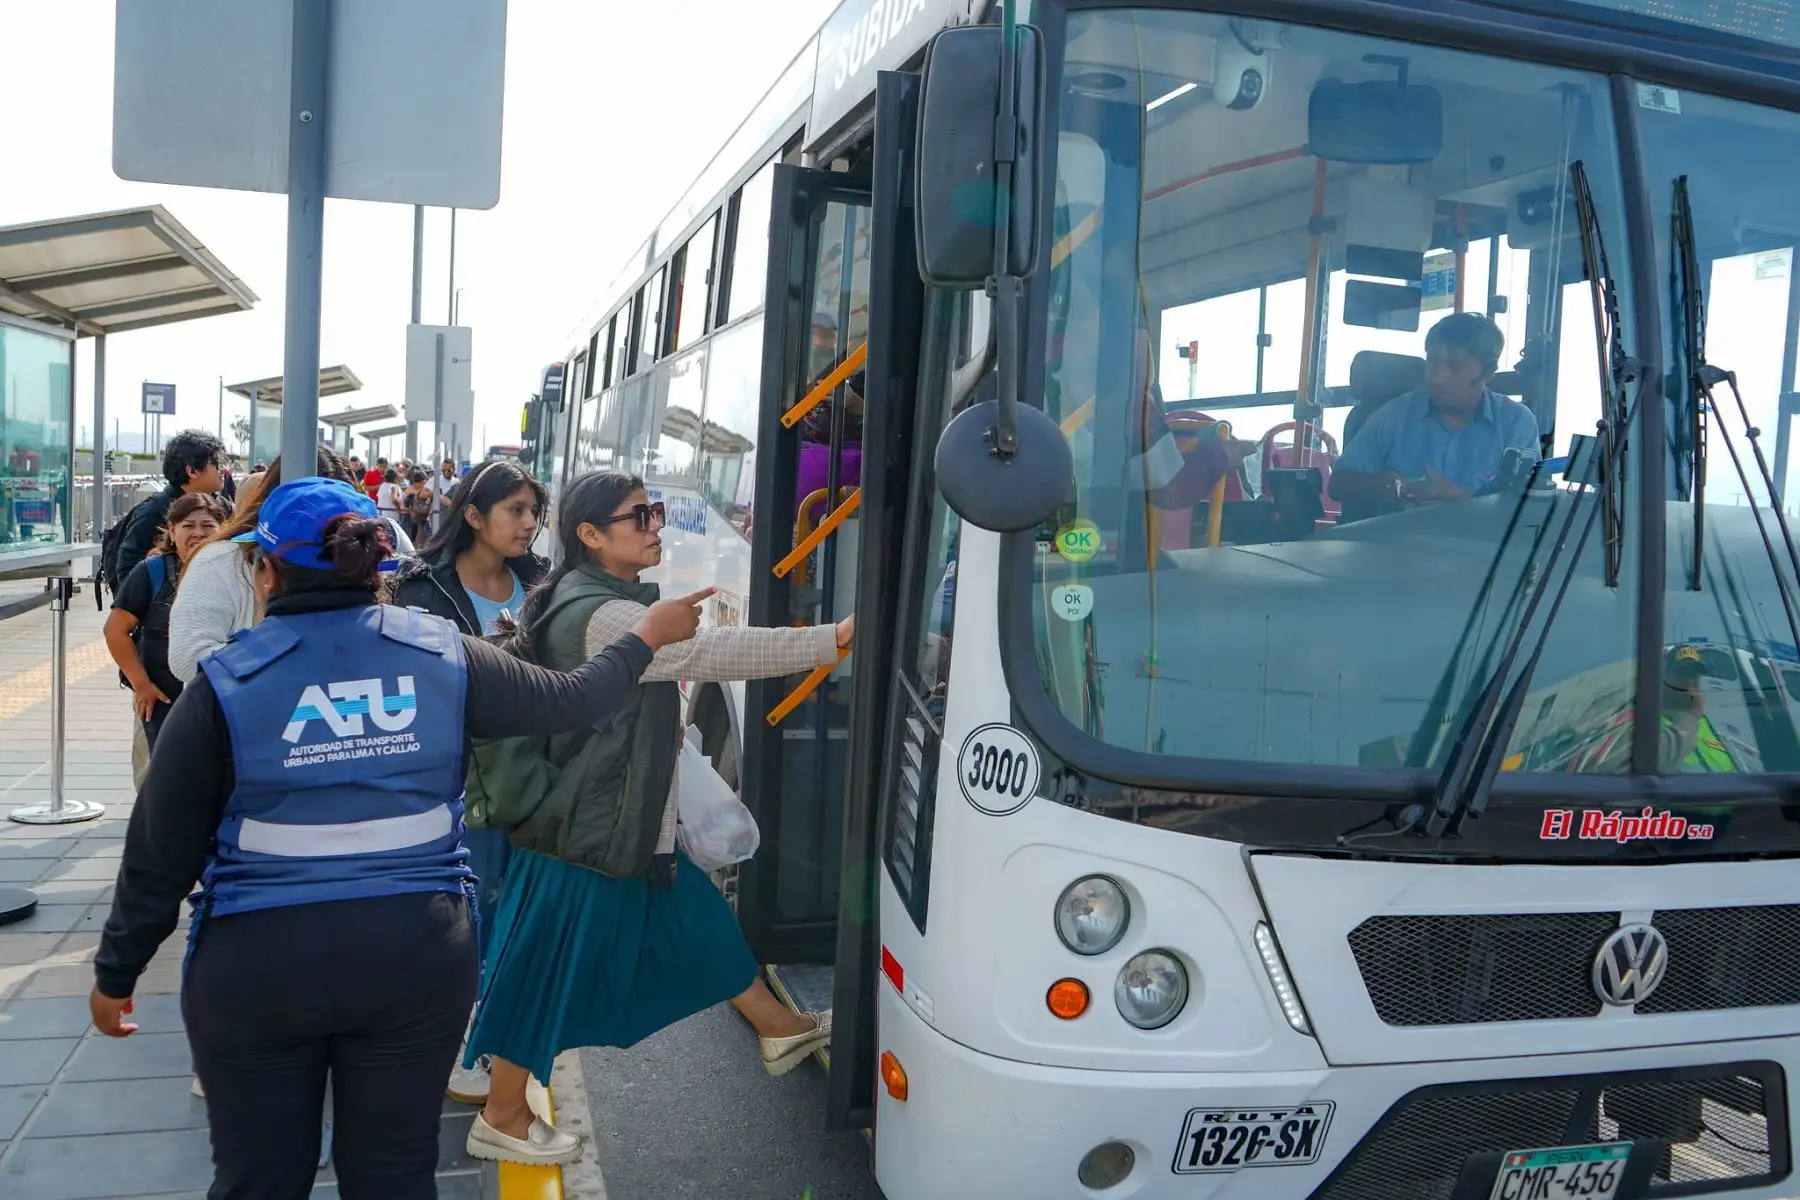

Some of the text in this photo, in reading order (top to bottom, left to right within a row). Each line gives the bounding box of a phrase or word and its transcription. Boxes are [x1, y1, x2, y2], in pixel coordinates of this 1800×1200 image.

[1064, 531, 1092, 547] OK
[1064, 593, 1082, 605] OK
[281, 675, 417, 744] ATU
[283, 742, 421, 768] URBANO PARA LIMA Y CALLAO
[289, 733, 415, 757] AUTORIDAD DE TRANSPORTE
[968, 742, 1028, 797] 3000
[1540, 809, 1573, 839] El
[1579, 807, 1687, 844] Rápido
[1203, 1106, 1315, 1122] RUTA
[1188, 1119, 1321, 1167] 1326-SX
[1501, 1161, 1619, 1200] CMR-456
